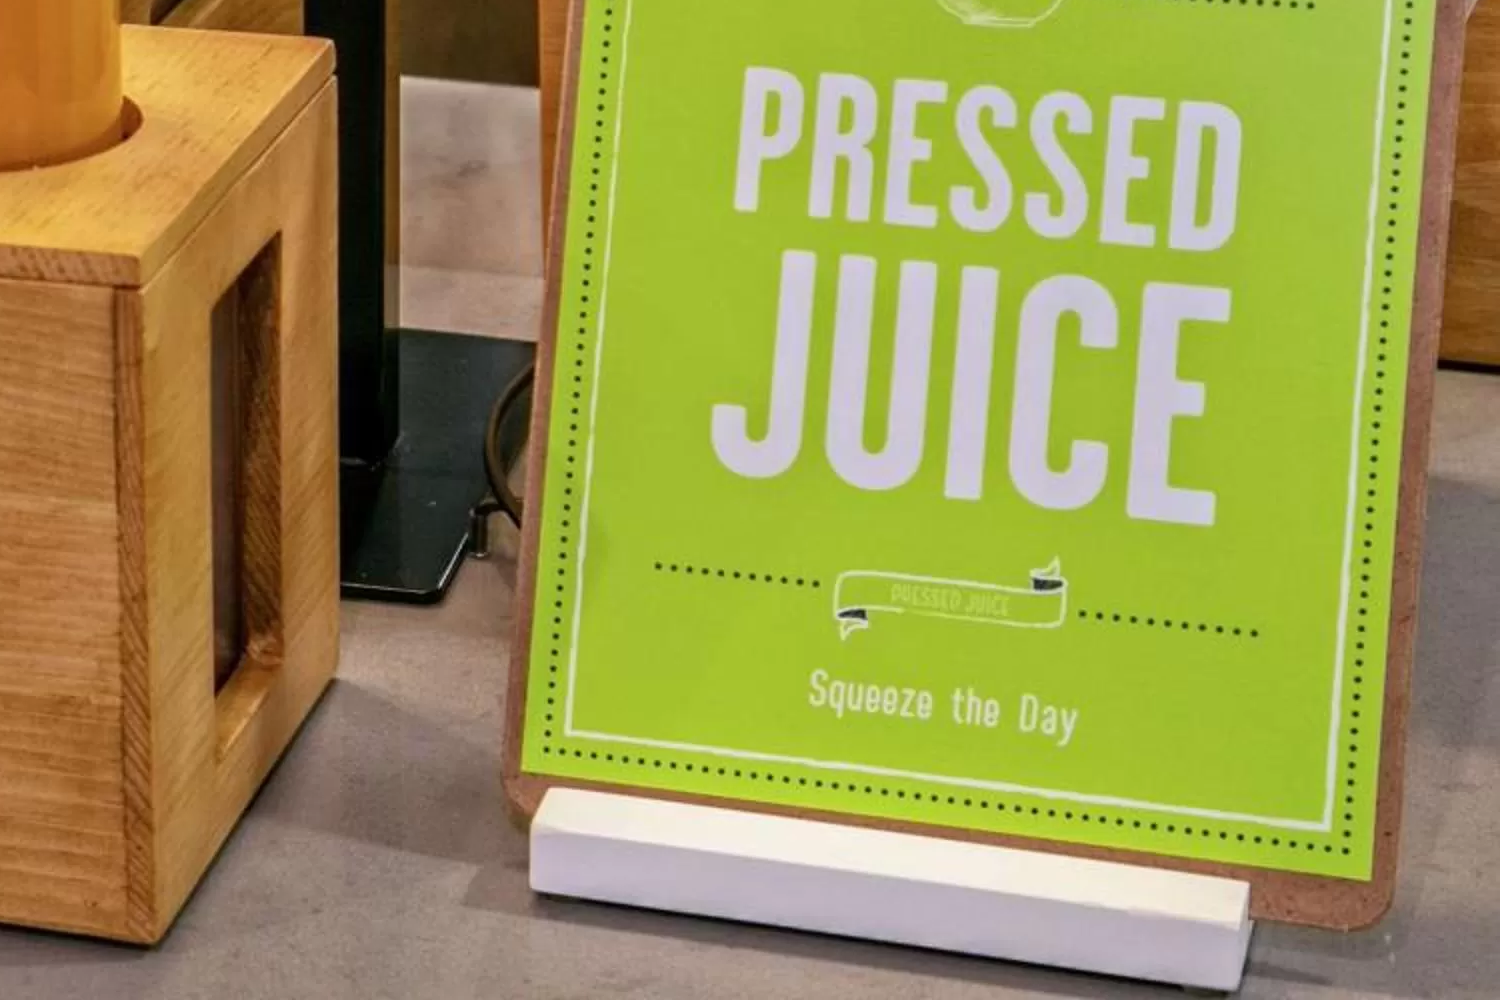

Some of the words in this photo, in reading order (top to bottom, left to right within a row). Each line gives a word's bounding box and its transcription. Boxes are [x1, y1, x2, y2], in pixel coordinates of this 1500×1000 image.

[733, 65, 1243, 253] PRESSED
[709, 247, 1233, 527] JUICE
[808, 667, 934, 720] Squeeze
[950, 686, 1001, 729] the
[1018, 692, 1080, 747] Day
